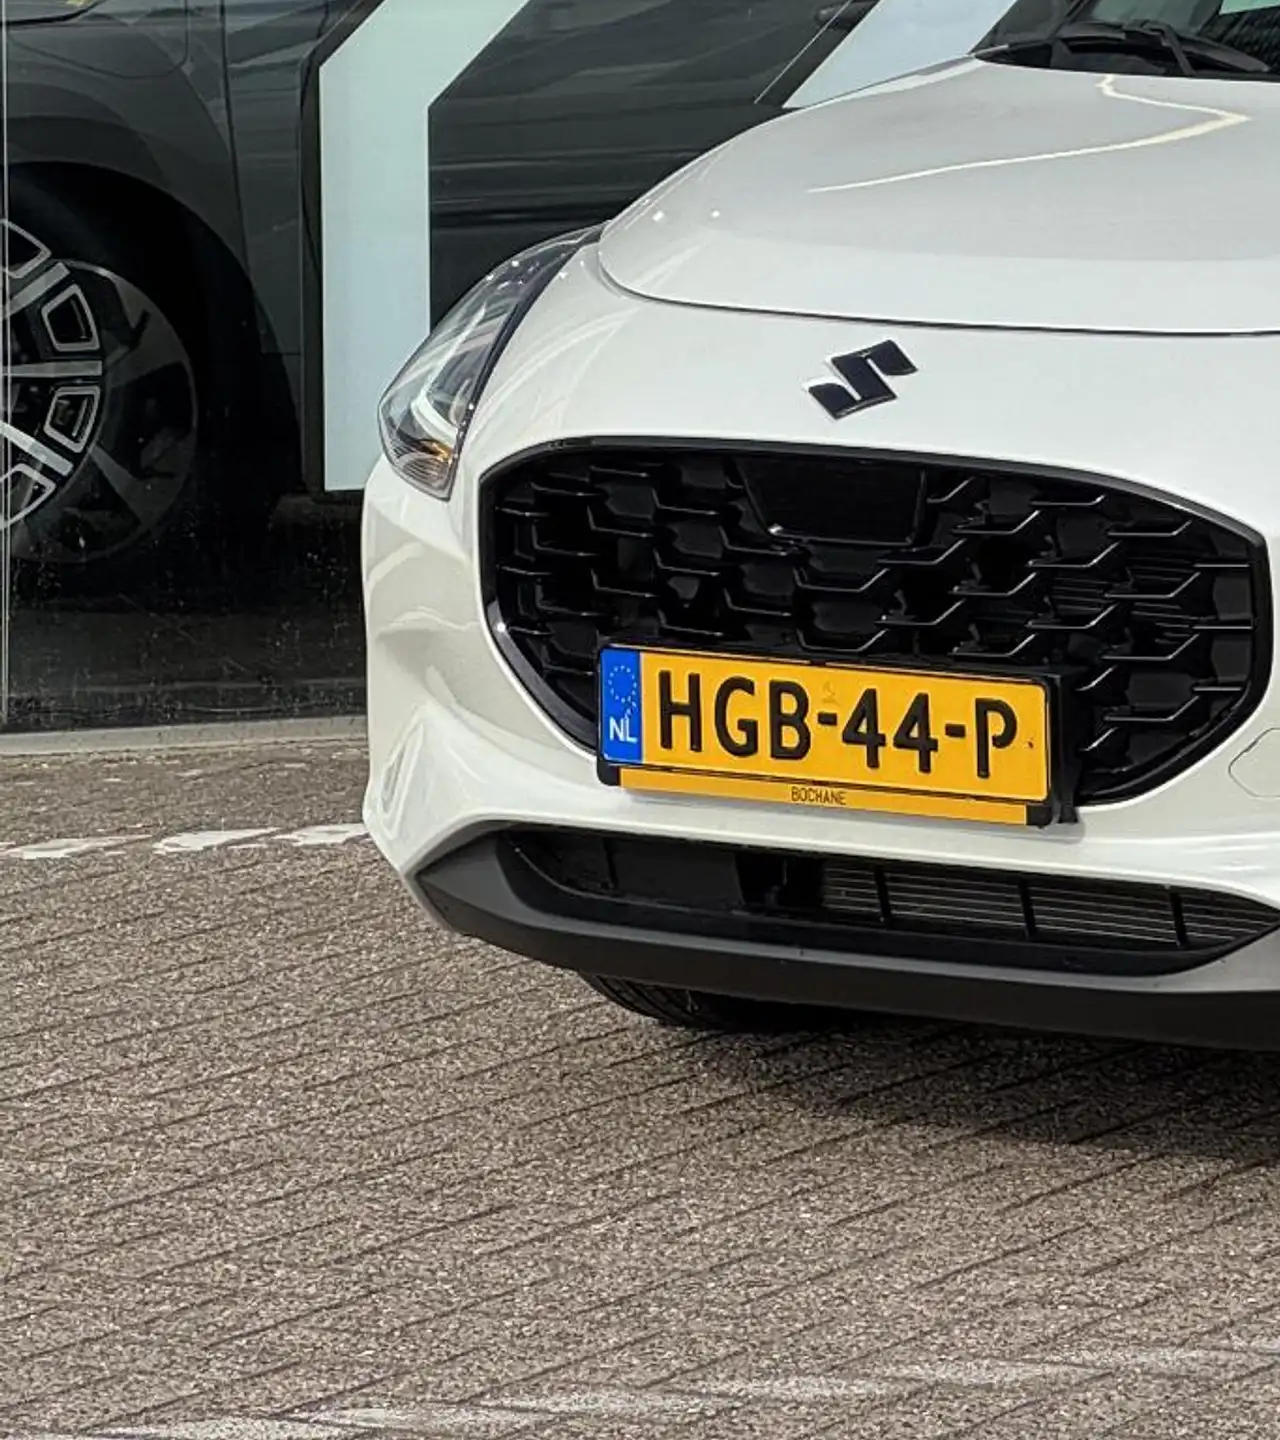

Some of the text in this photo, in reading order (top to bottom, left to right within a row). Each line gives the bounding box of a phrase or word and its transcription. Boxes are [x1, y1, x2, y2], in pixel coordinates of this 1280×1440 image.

[608, 717, 638, 744] NL
[657, 669, 1018, 779] HGB-44-P
[790, 786, 847, 806] BOCHANE
